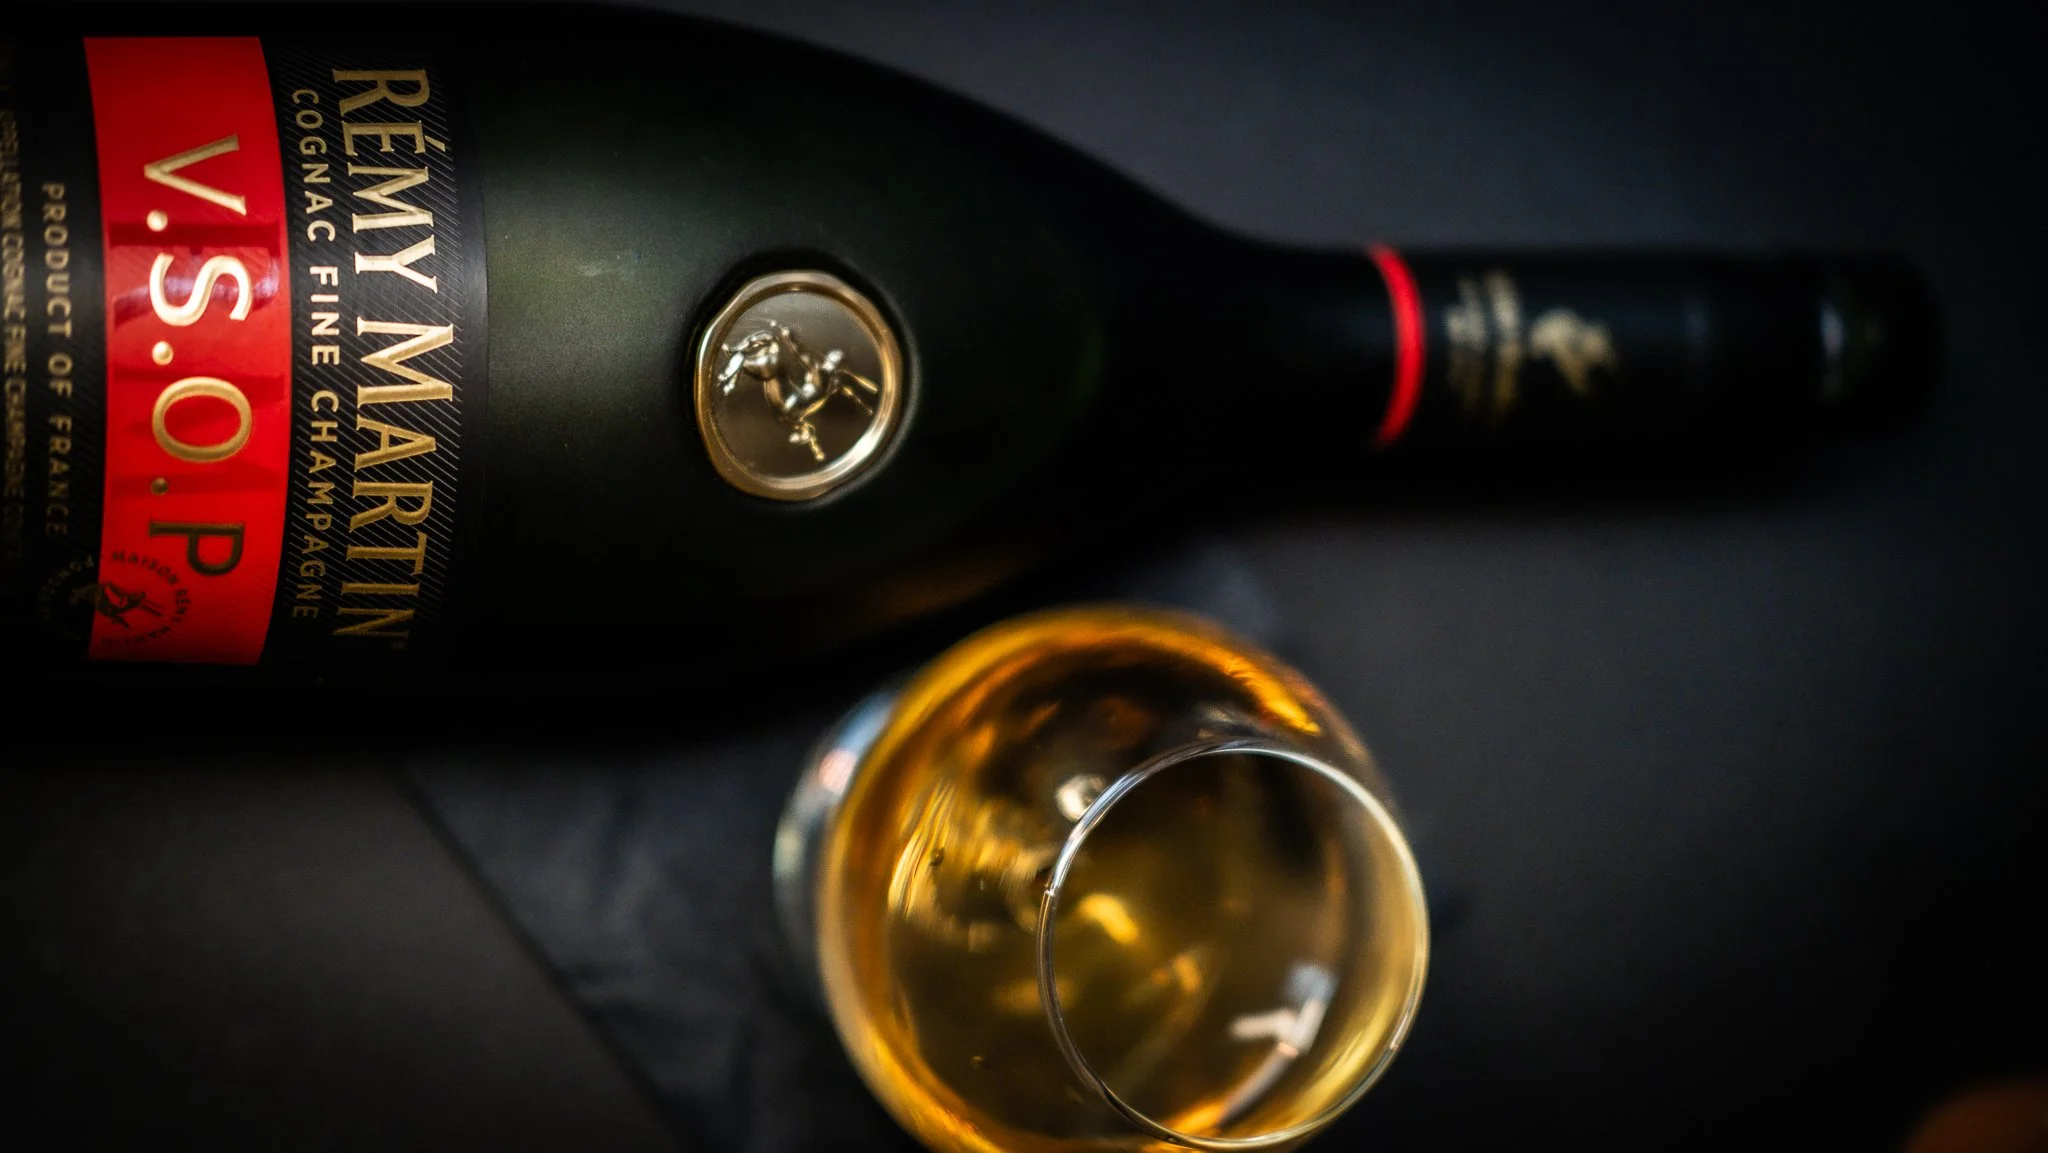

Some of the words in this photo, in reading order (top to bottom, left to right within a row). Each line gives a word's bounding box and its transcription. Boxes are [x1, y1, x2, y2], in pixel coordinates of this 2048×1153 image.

[292, 89, 337, 241] COGNAC
[331, 68, 445, 294] RÉMY
[41, 182, 72, 338] PRODUCT
[310, 266, 340, 365] FINE
[48, 353, 73, 396] OF
[144, 134, 253, 577] V.S.O.P
[44, 416, 72, 535] FRANCE
[292, 390, 340, 619] CHAMPAGNE
[333, 317, 455, 638] MARTIN
